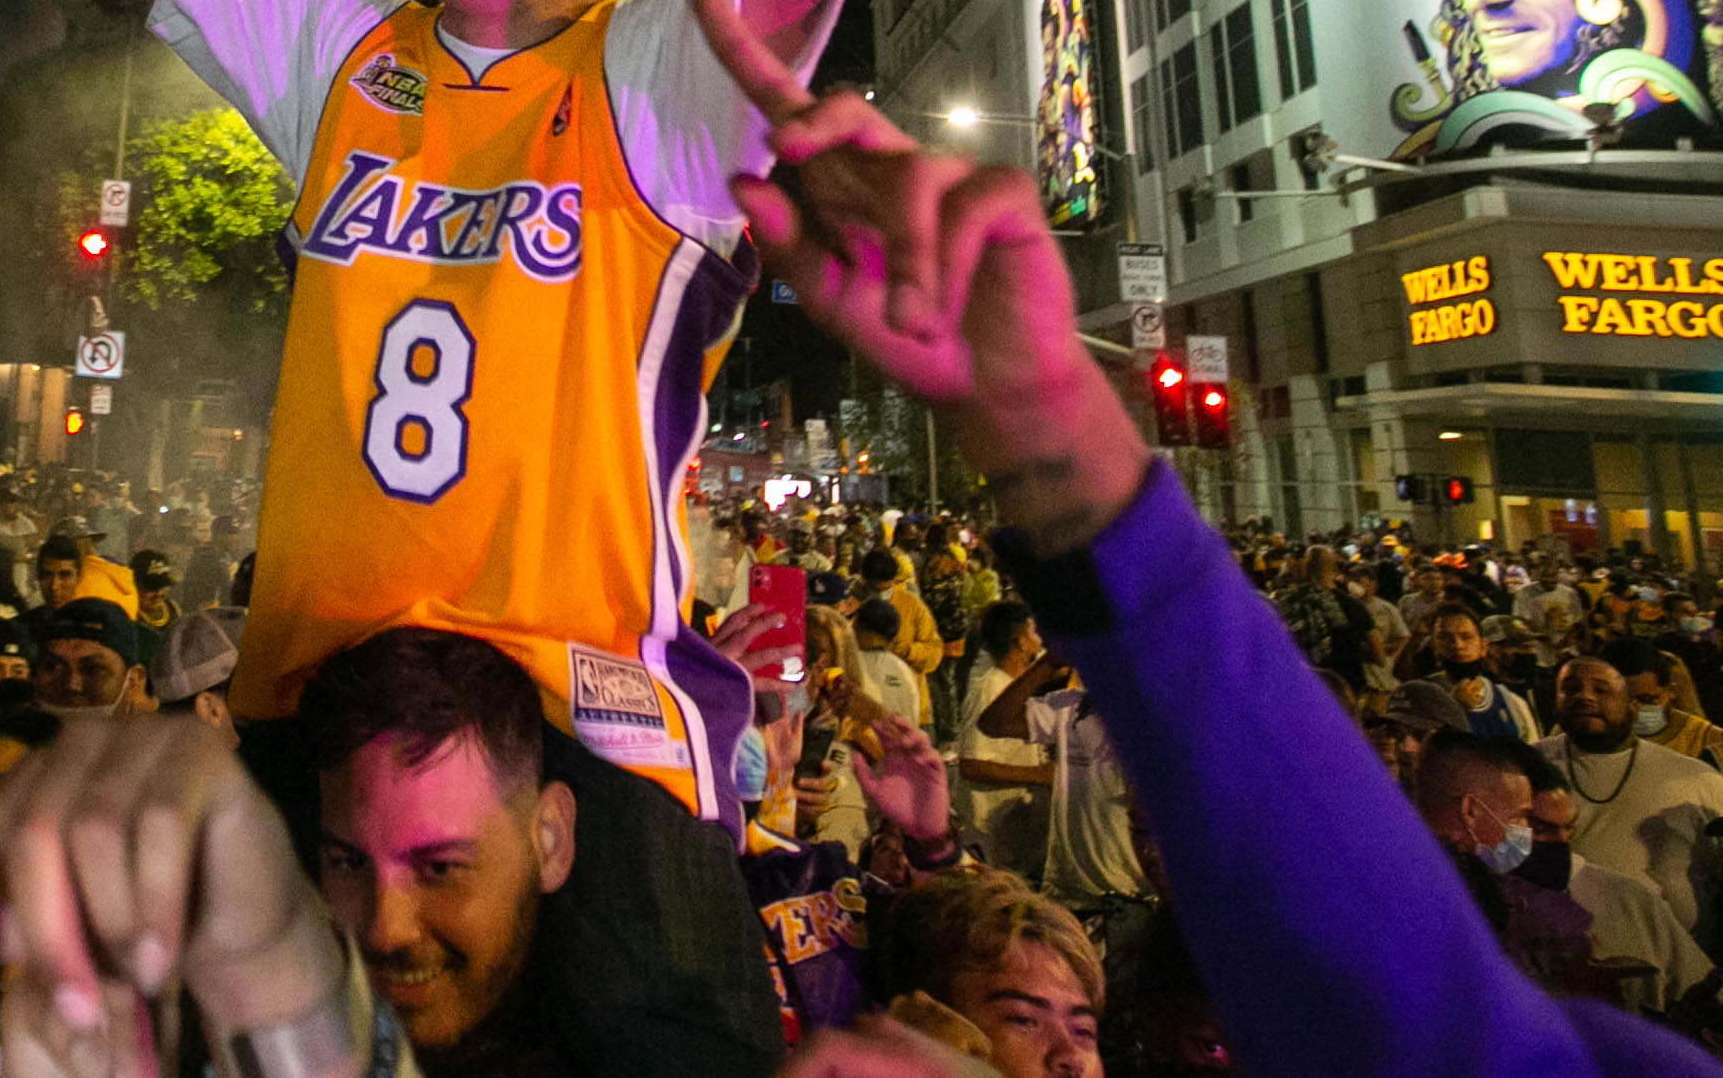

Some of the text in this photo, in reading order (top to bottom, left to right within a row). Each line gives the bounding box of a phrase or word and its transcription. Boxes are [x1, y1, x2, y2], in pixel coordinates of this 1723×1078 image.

[375, 71, 426, 99] NBA
[299, 149, 583, 284] LAKERS
[1402, 255, 1490, 304] WELLS
[1409, 298, 1495, 346] FARGO
[361, 296, 476, 506] 8
